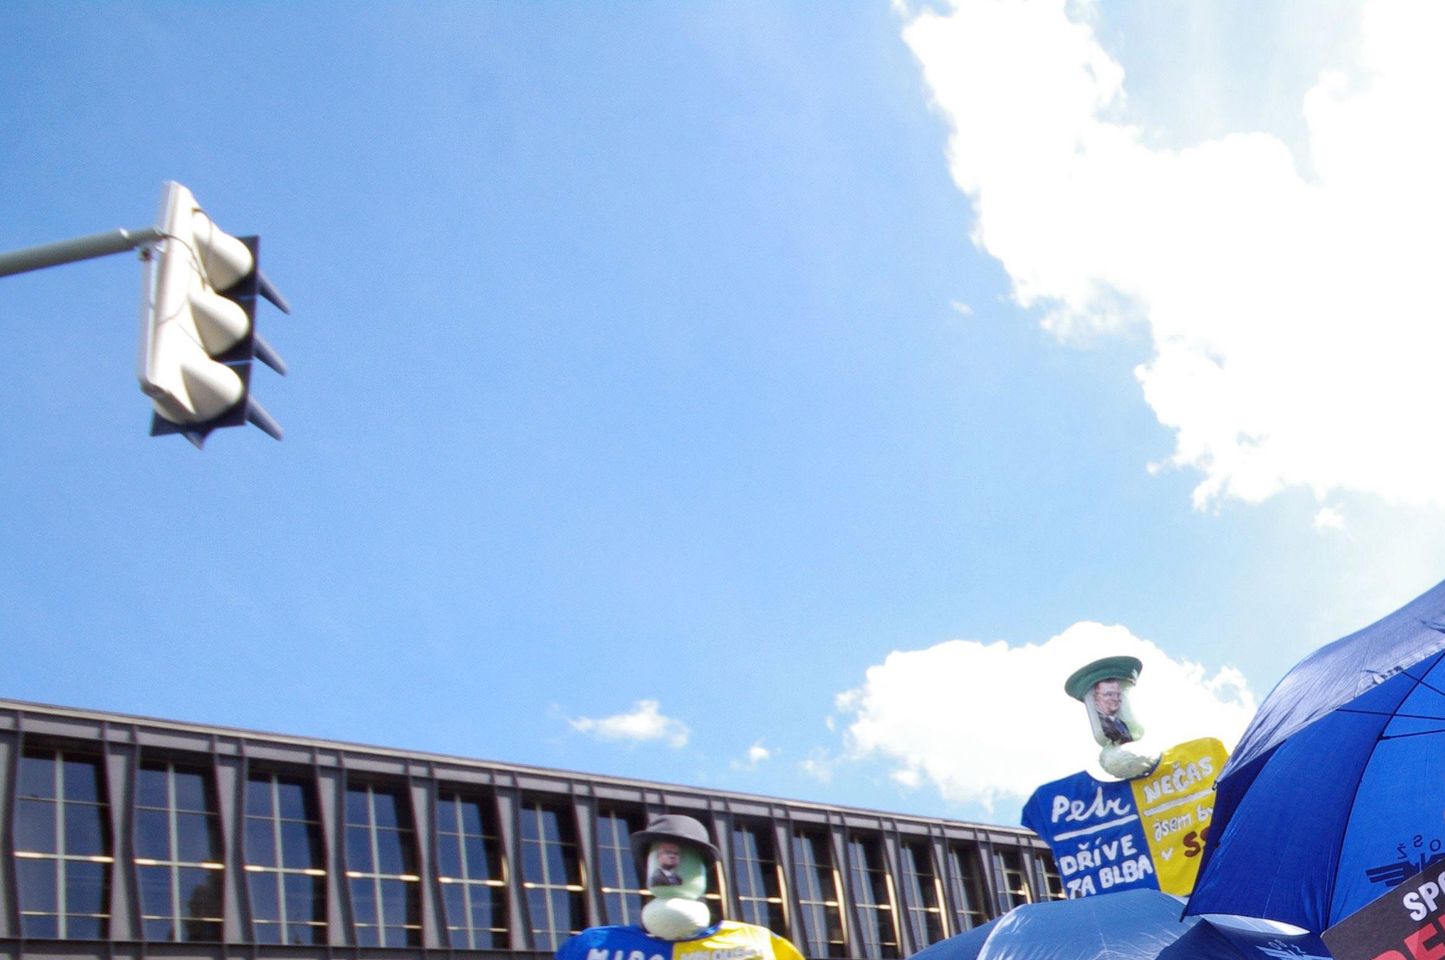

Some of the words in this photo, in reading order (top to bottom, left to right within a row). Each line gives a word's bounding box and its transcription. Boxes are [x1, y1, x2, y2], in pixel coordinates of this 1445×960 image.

[1143, 756, 1213, 804] NEČAS
[1052, 787, 1131, 823] Petr
[1060, 834, 1138, 876] DŘÍVE
[1067, 875, 1097, 899] ZA
[1100, 855, 1154, 889] BLBA
